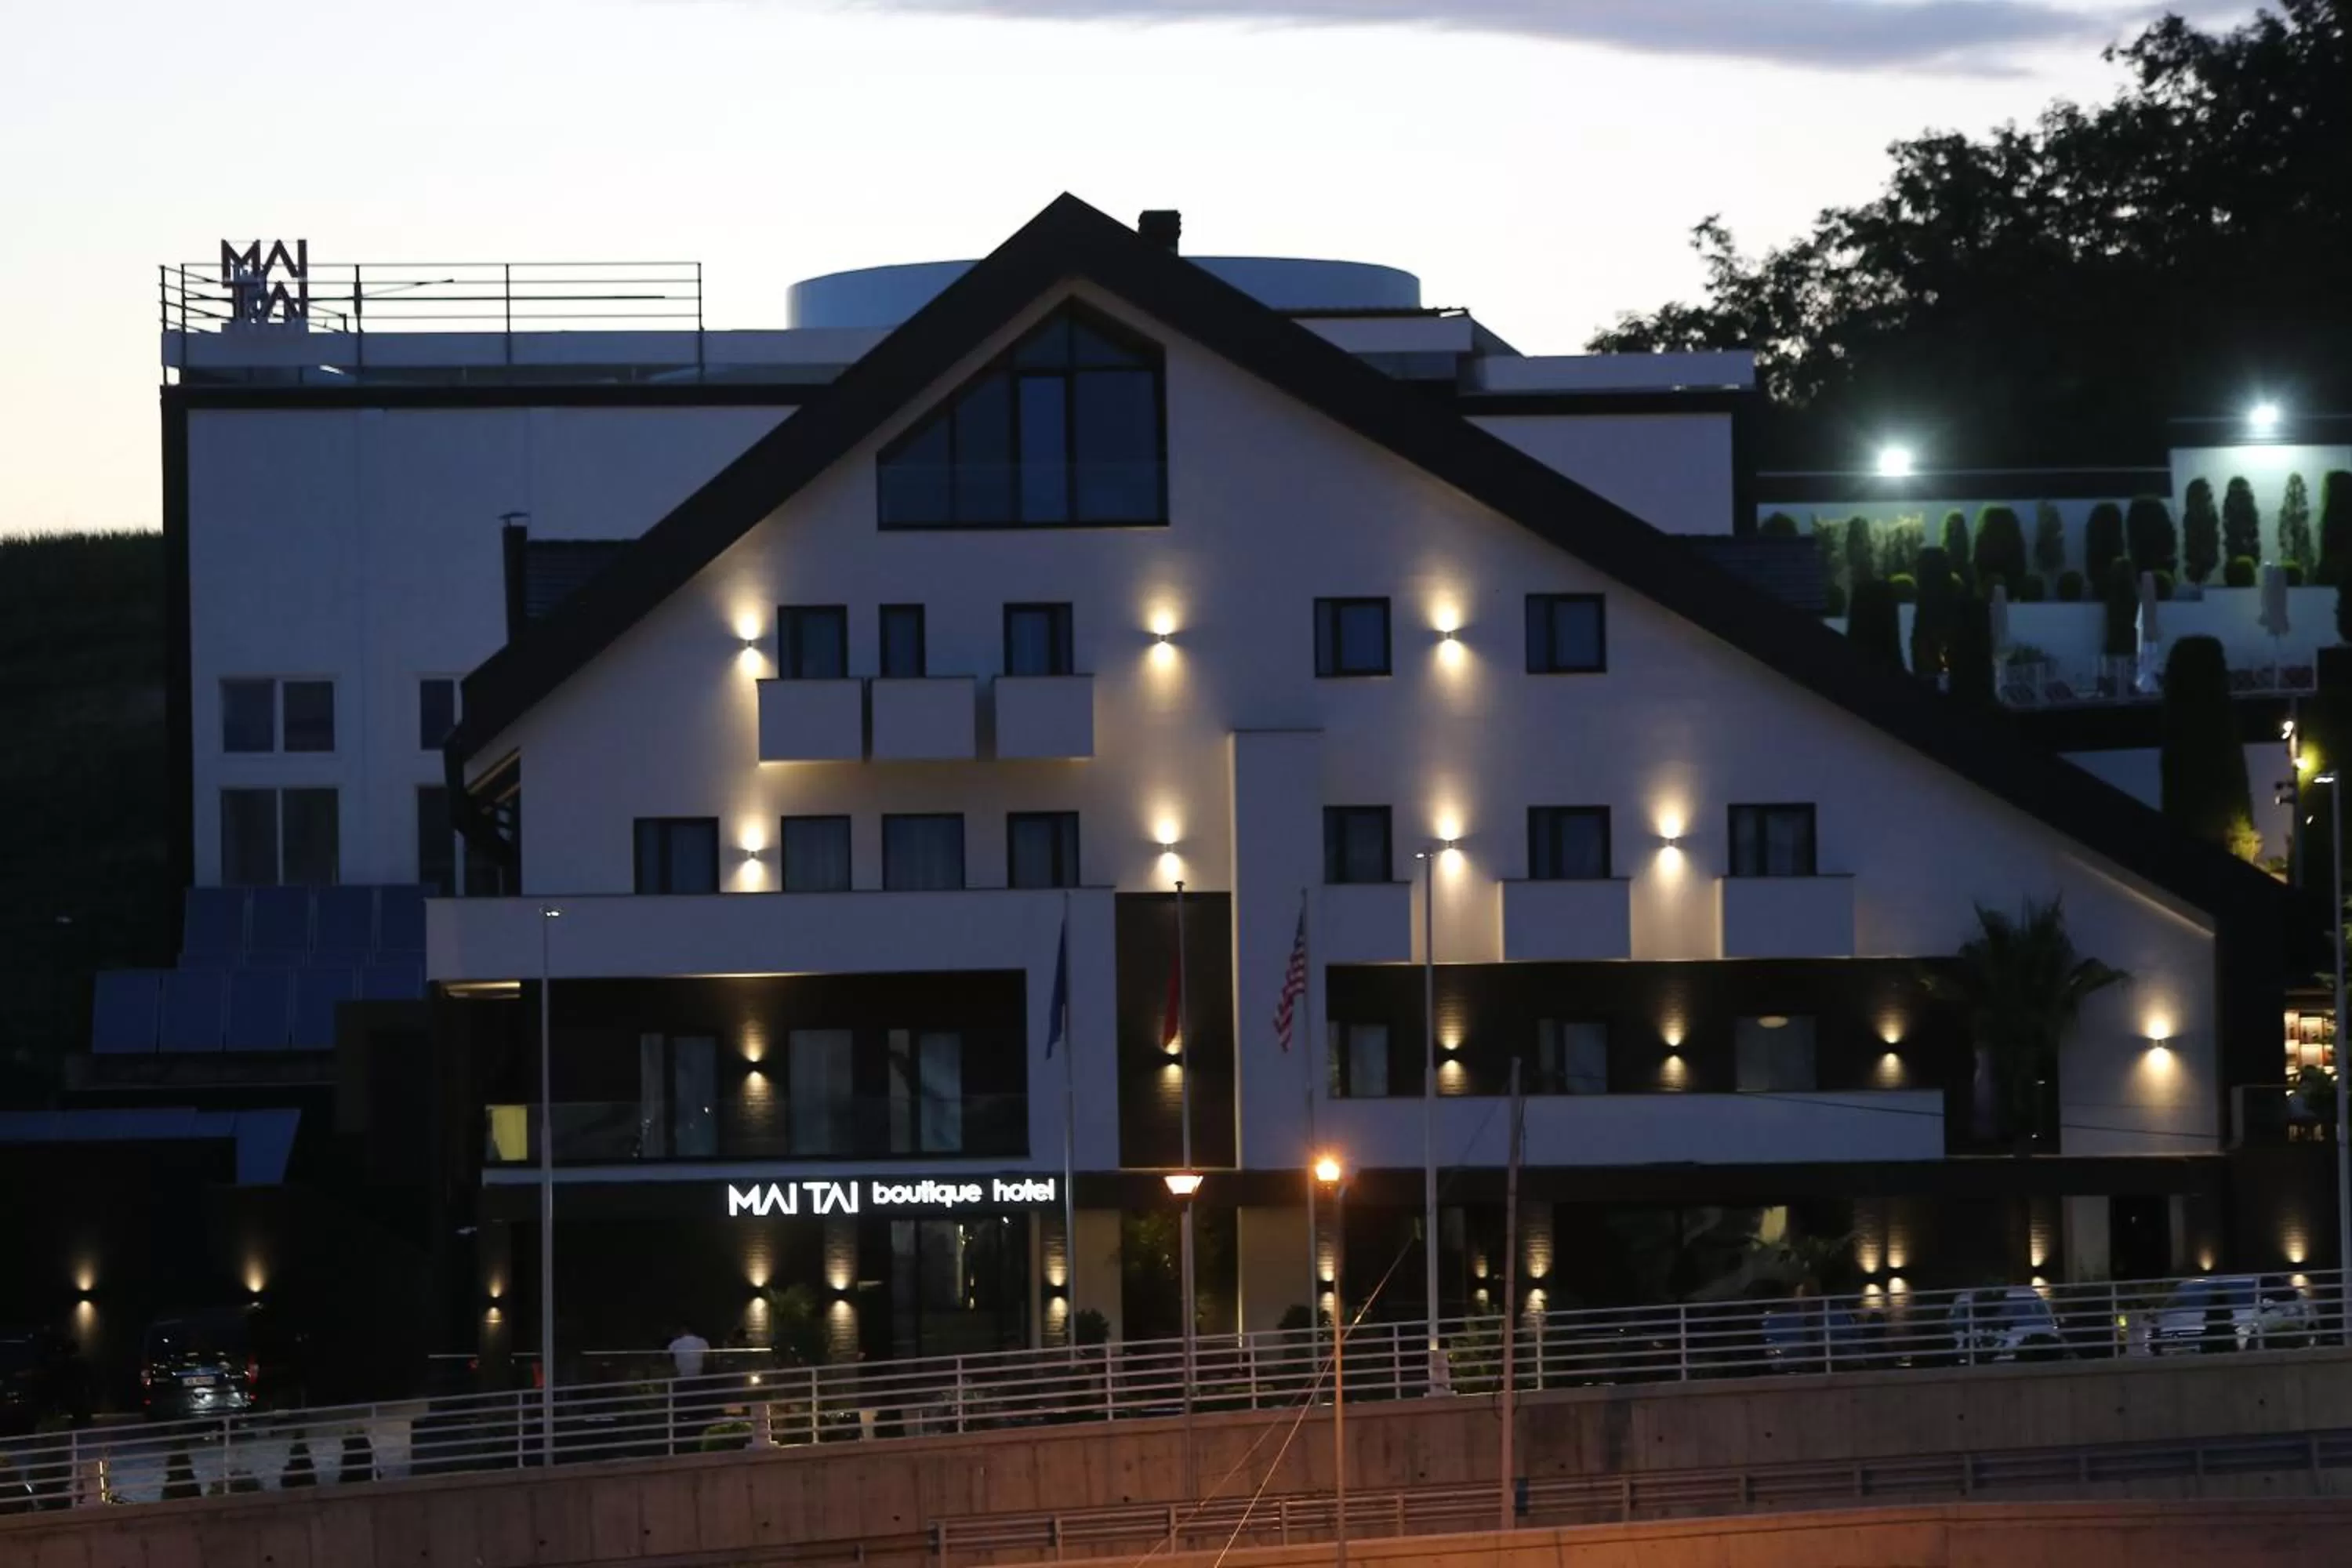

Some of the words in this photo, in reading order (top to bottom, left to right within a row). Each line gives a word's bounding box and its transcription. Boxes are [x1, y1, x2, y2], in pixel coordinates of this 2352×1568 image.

[221, 238, 307, 279] MAI
[221, 280, 308, 322] TAI
[728, 1182, 798, 1217] MAI
[802, 1181, 859, 1214] TAI
[872, 1180, 982, 1207] boutique
[993, 1178, 1055, 1202] hotel
